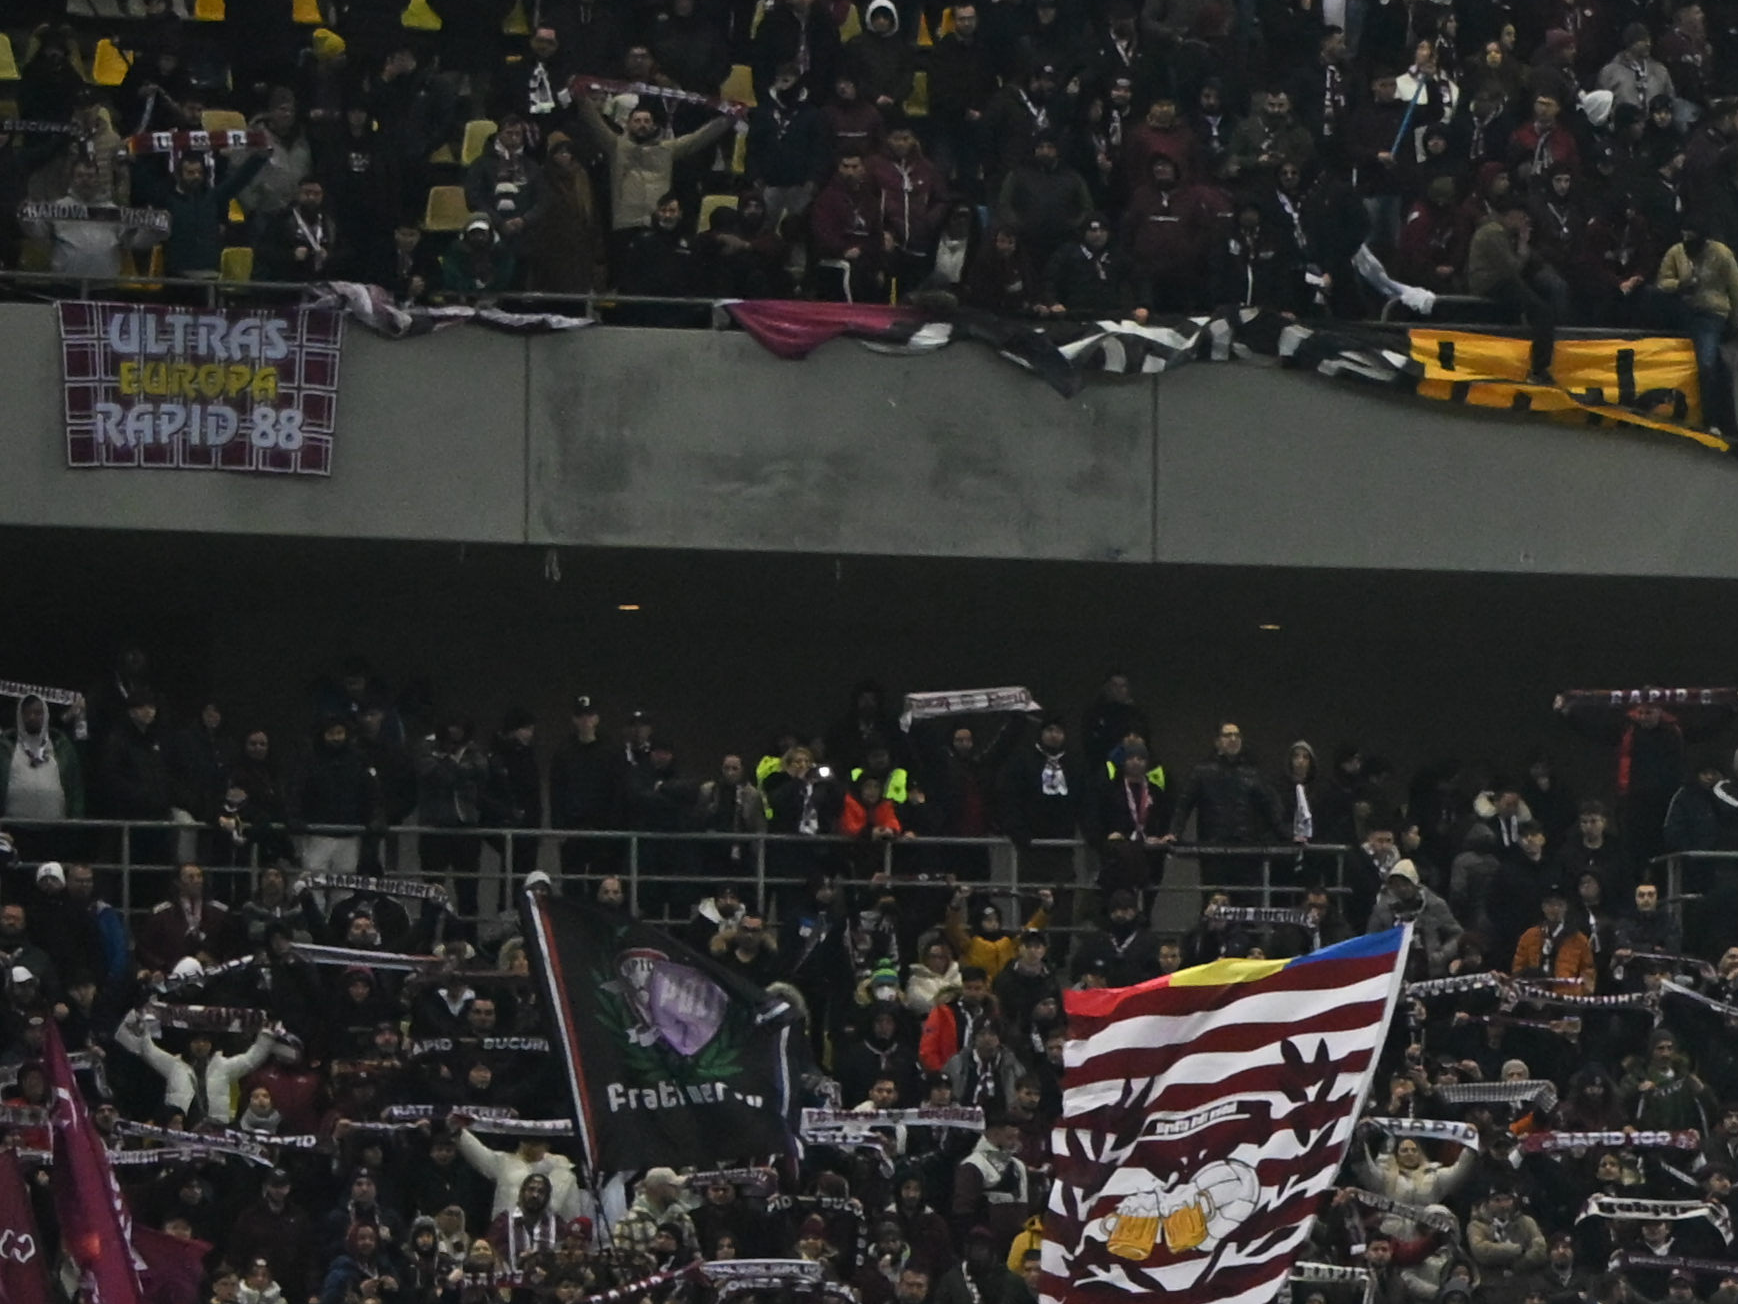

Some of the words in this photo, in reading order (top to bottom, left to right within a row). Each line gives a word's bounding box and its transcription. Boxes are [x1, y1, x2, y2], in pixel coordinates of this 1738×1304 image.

[107, 313, 290, 361] ULTRAS
[119, 361, 277, 399] EUROPA
[94, 402, 237, 449] RAPID
[250, 402, 304, 451] 88
